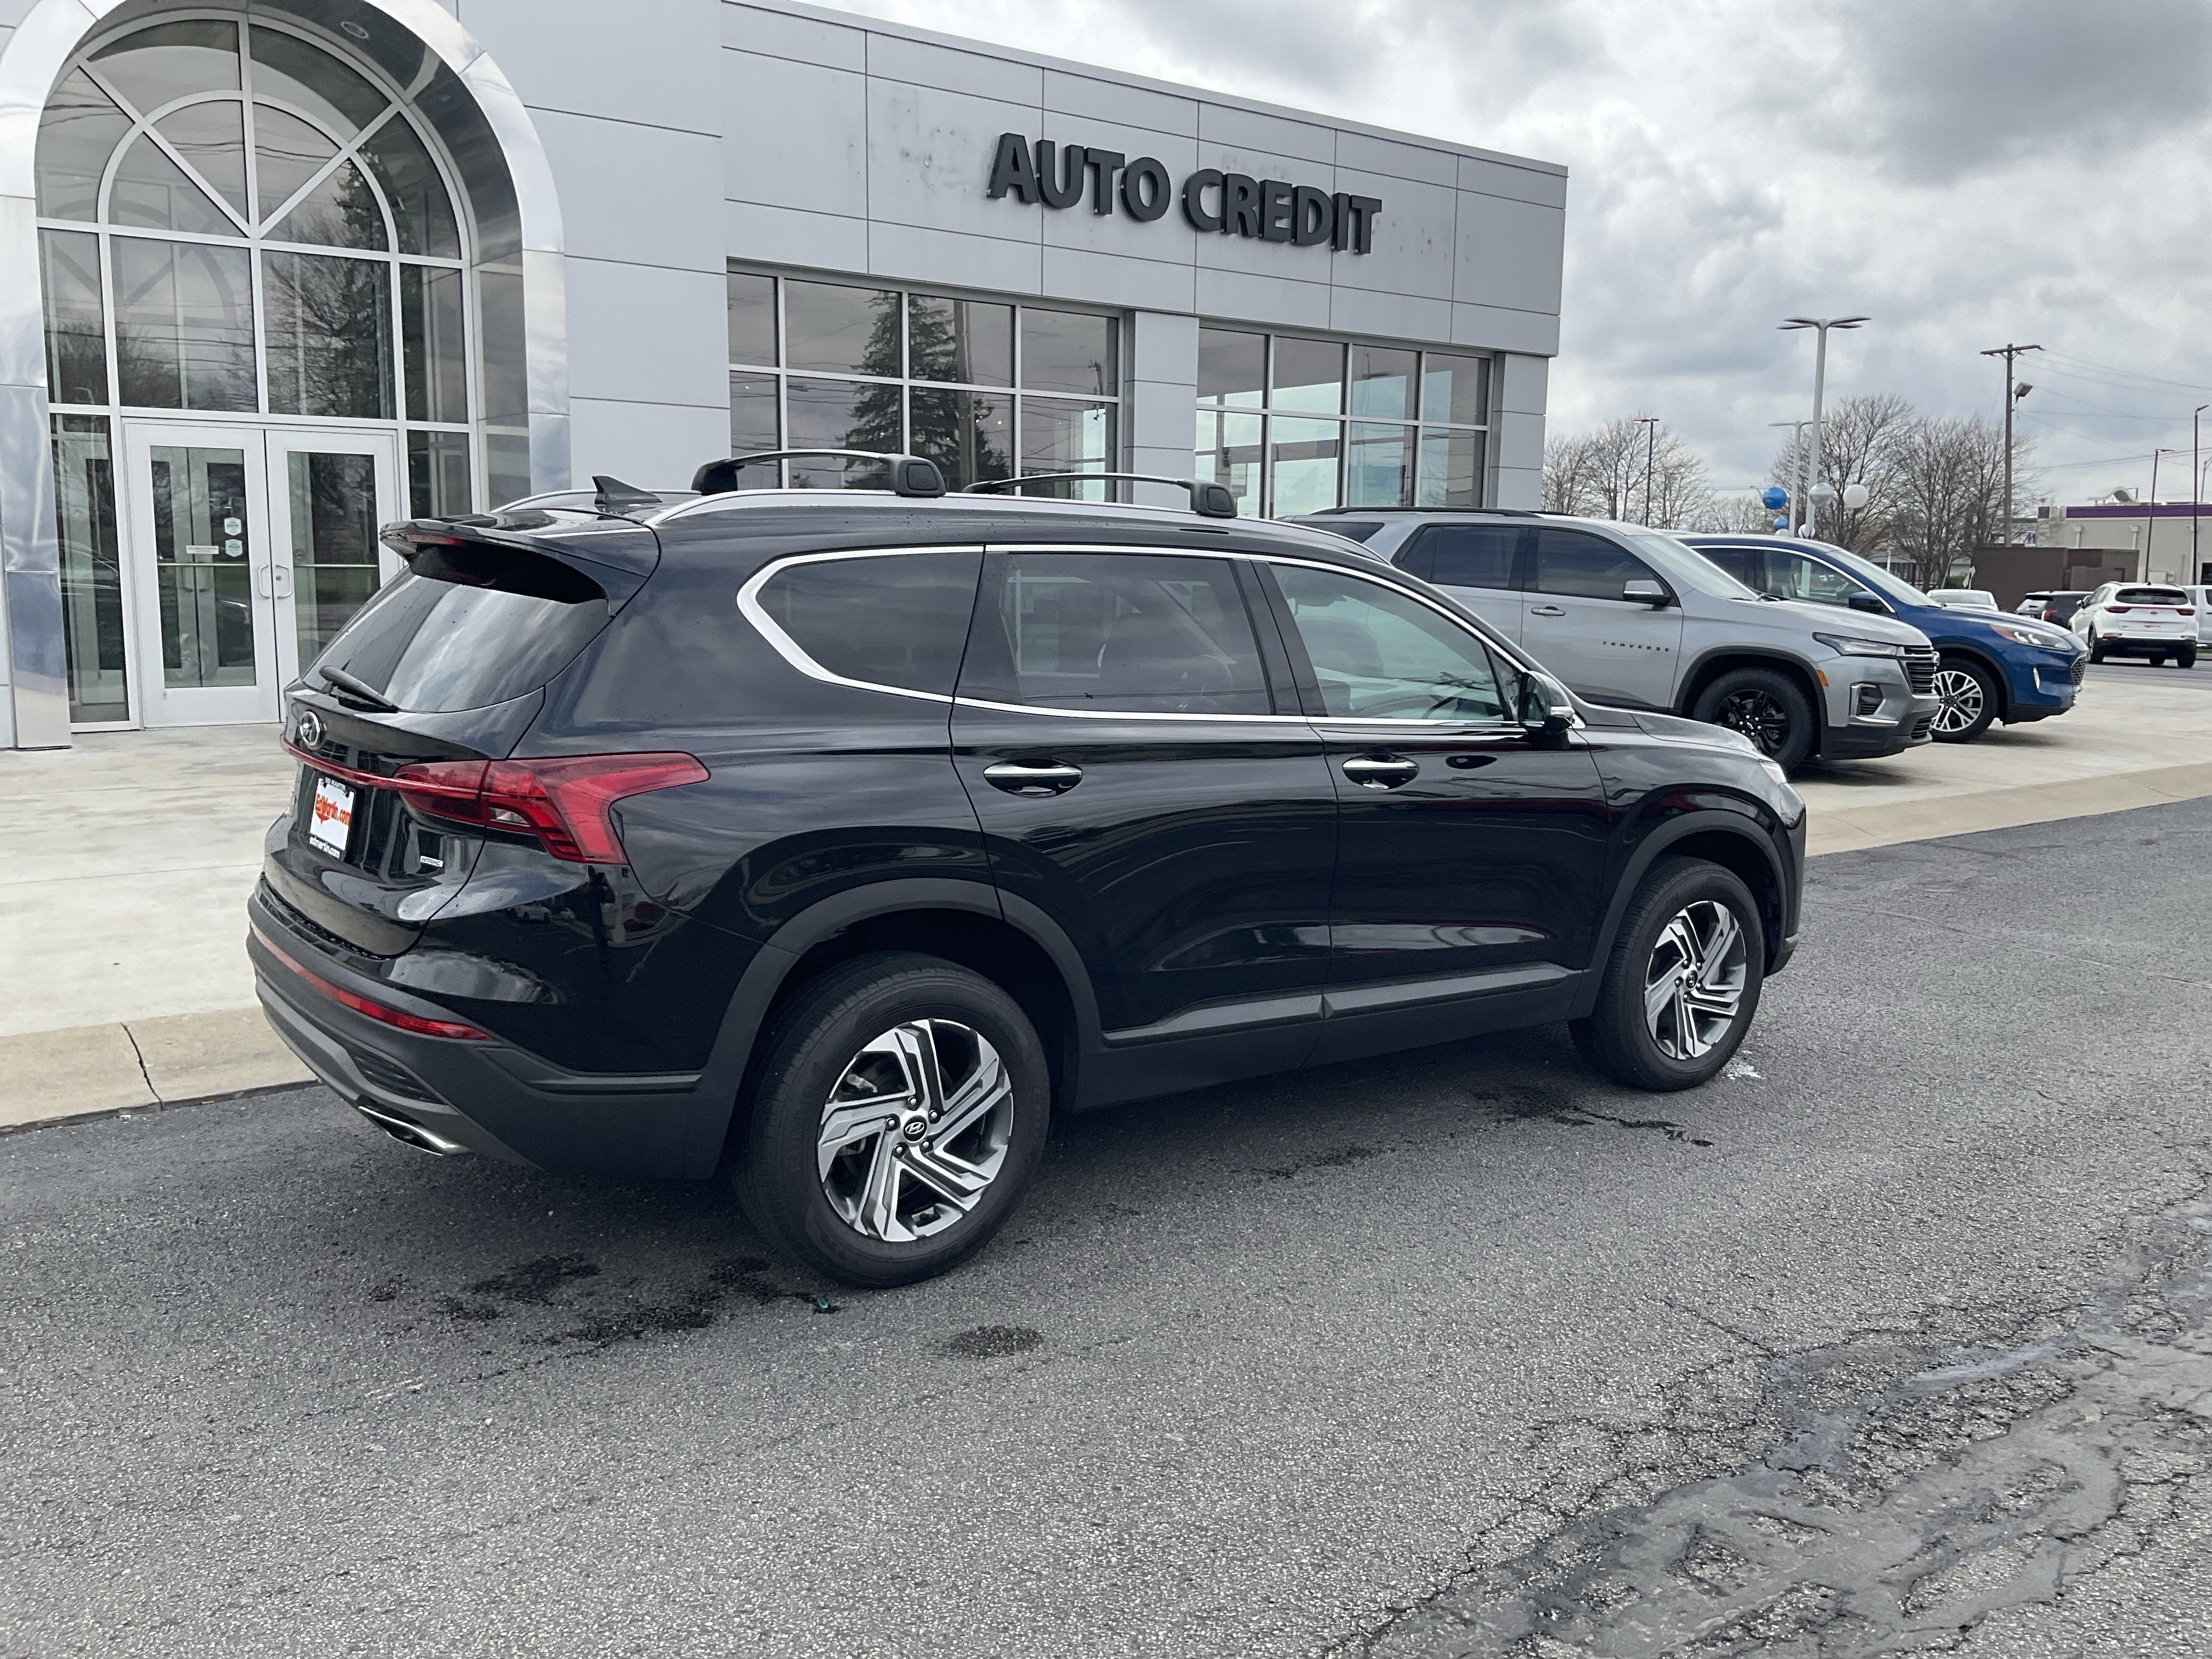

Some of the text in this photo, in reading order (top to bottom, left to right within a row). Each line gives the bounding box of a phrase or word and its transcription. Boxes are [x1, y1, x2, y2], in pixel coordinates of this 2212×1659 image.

[988, 133, 1383, 255] AUTO CREDIT
[1602, 641, 1669, 652] TRAVERSE
[421, 857, 441, 866] HTRAC
